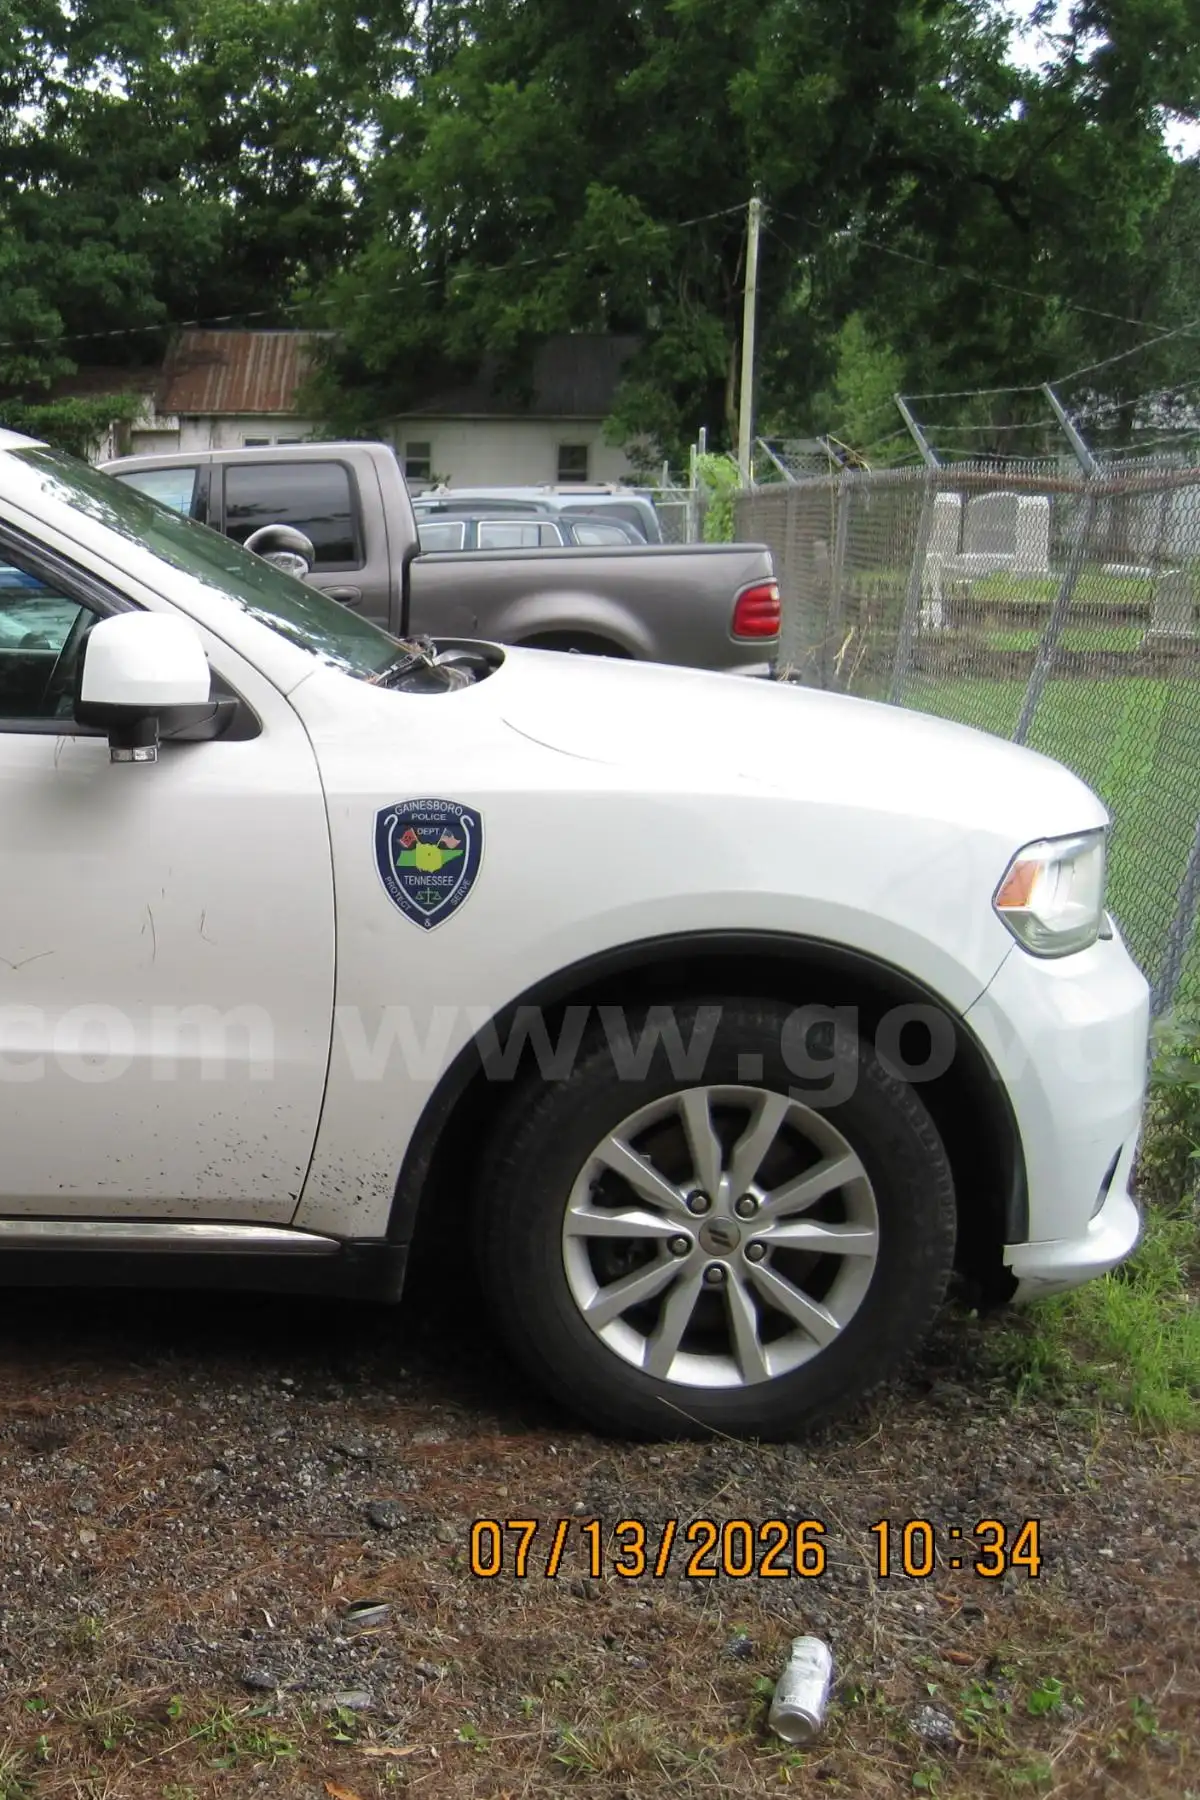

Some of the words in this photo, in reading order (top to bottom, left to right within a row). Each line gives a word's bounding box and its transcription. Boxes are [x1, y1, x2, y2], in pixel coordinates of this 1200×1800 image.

[395, 800, 463, 816] GAINESBORO
[411, 813, 447, 821] POLICE
[417, 828, 440, 836] DEPT
[404, 875, 454, 886] TENNESSEE
[385, 876, 412, 911] PROTECT
[450, 878, 471, 905] SERVE
